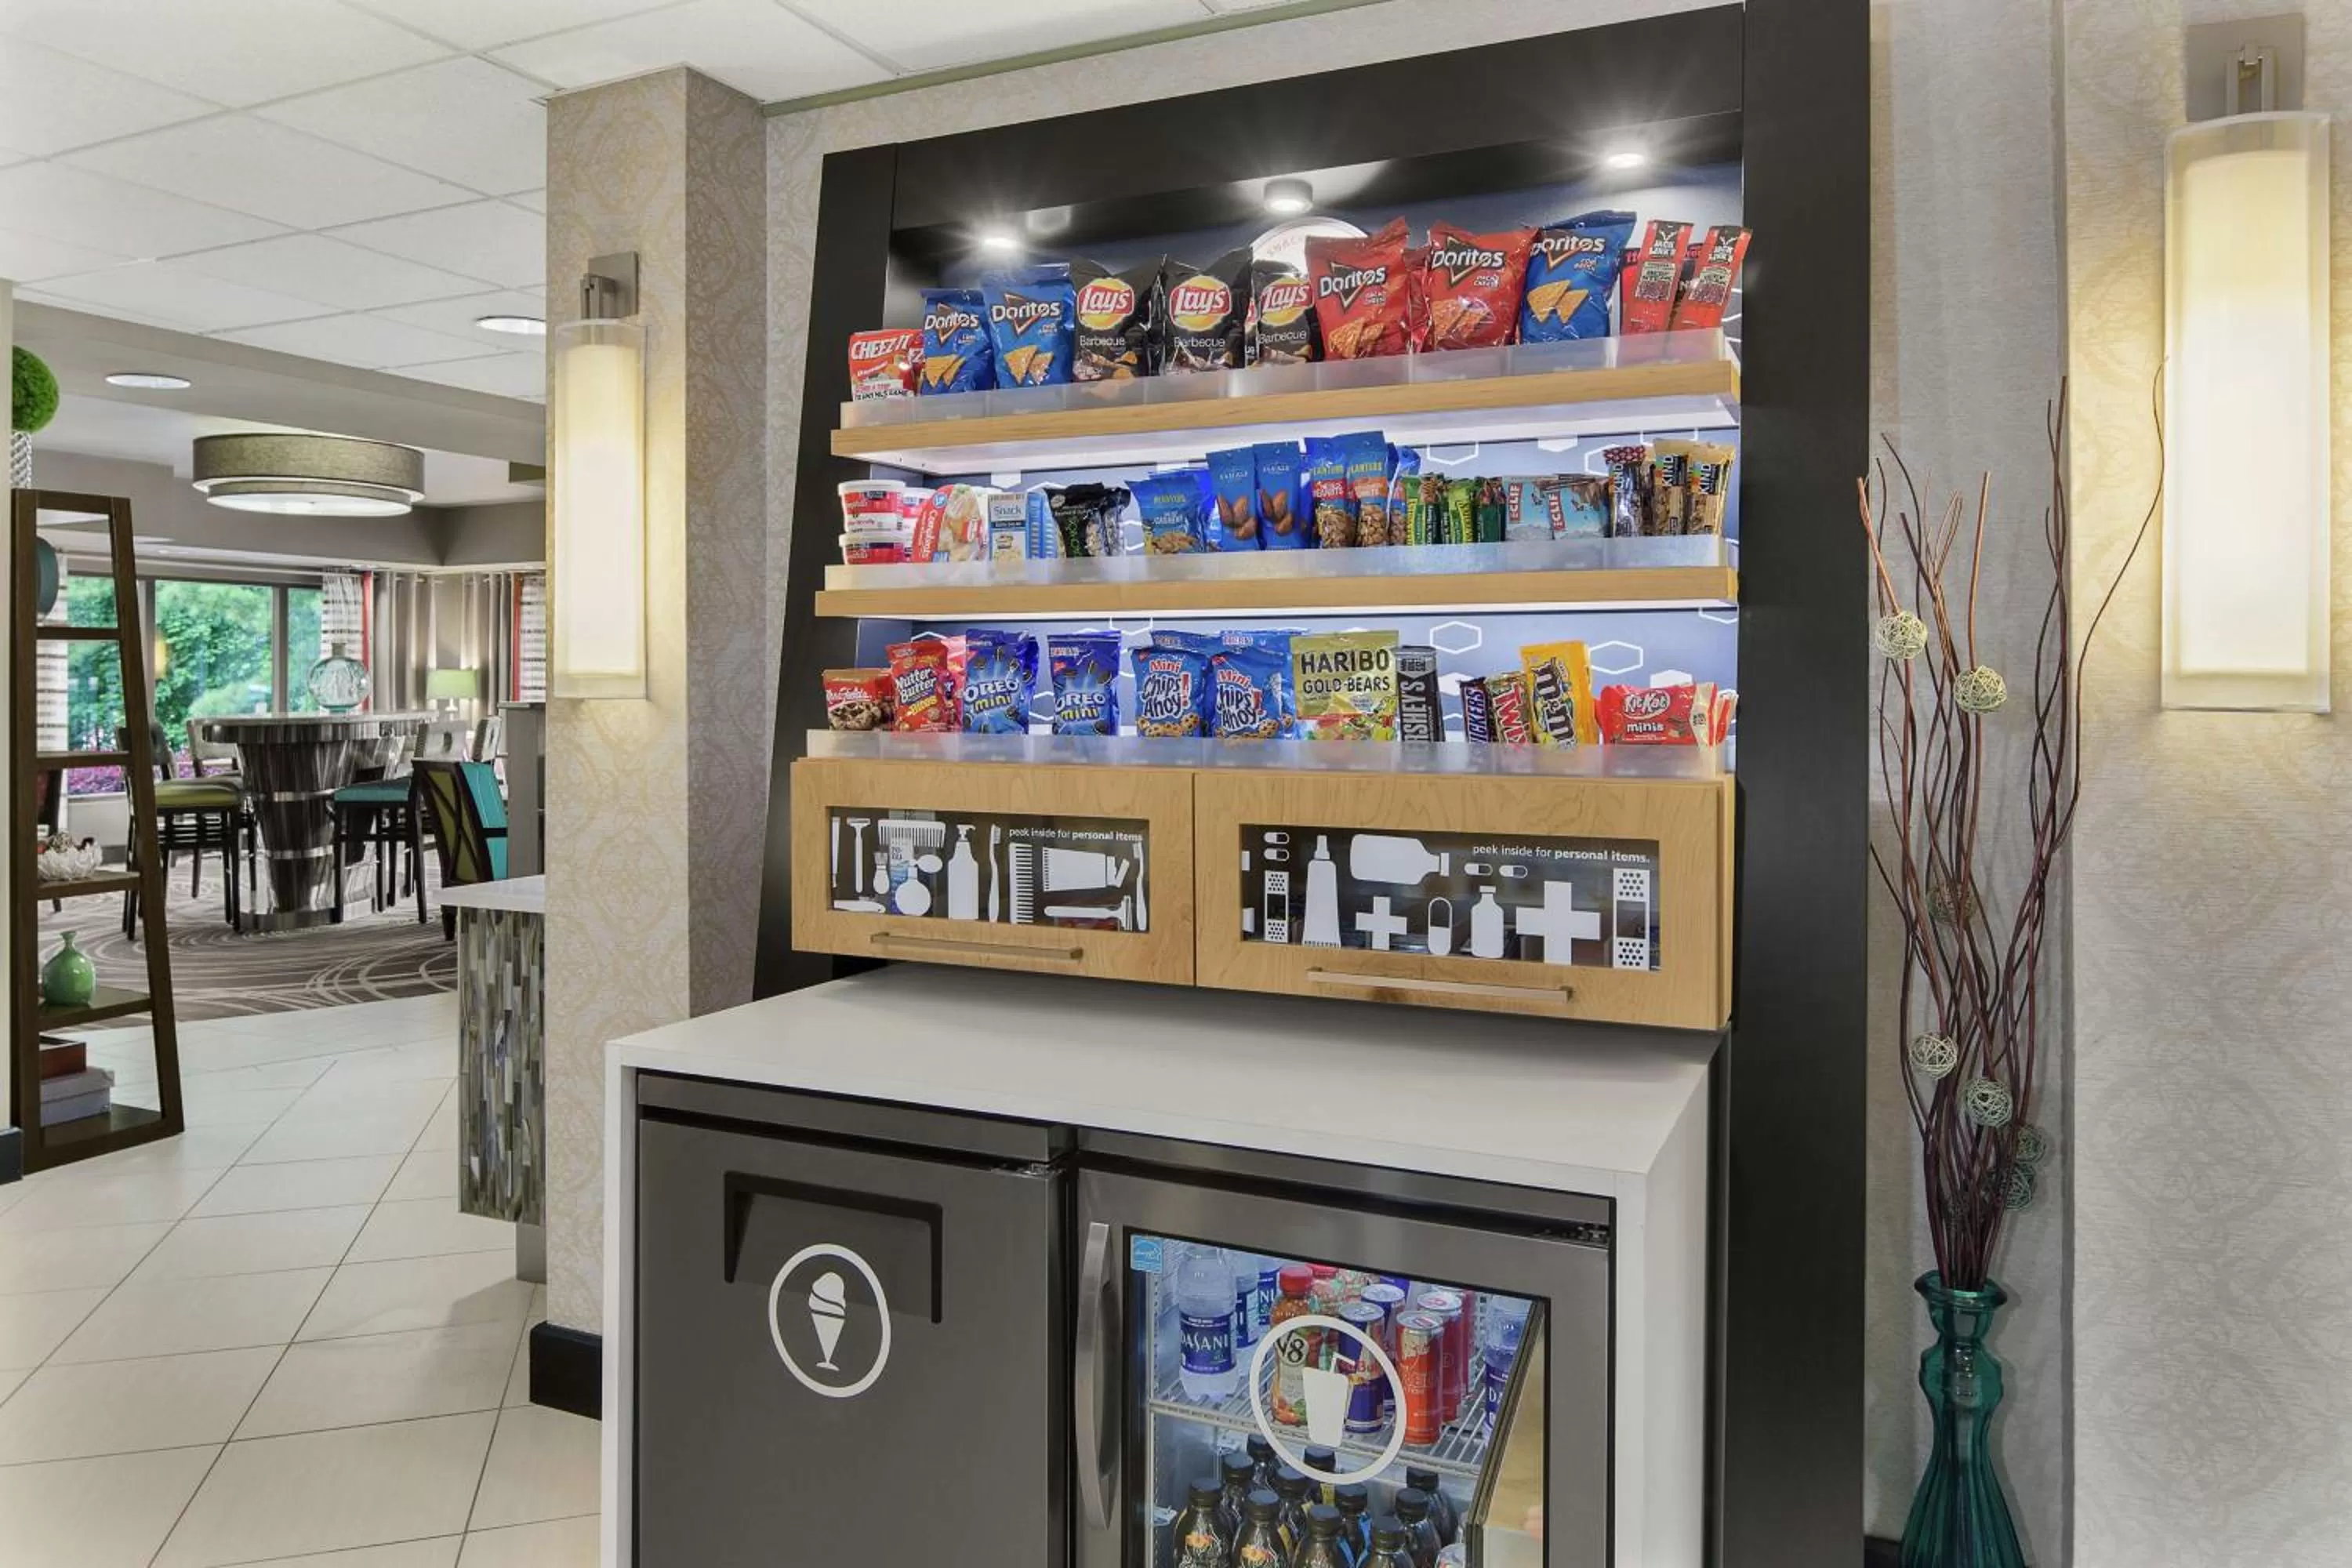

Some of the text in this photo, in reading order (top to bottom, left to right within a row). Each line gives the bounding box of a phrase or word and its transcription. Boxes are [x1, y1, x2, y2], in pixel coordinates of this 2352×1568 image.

[1432, 250, 1505, 268] Doritos
[1319, 267, 1387, 298] Doritos
[991, 301, 1062, 322] Doritos
[924, 313, 979, 331] Doritos
[1079, 335, 1127, 347] Barbecue
[1174, 336, 1226, 349] Barbecue
[1259, 330, 1308, 343] Barbecue
[1614, 463, 1624, 493] KIND
[1662, 456, 1674, 487] KIND
[1700, 463, 1711, 495] KIND
[1150, 658, 1182, 673] Mini
[1301, 648, 1389, 674] HARIBO
[895, 668, 932, 689] Nutter
[1142, 673, 1182, 699] Chips
[1218, 669, 1252, 687] Mini
[1302, 675, 1391, 695] GOLD-BEARS
[901, 677, 938, 703] Butter
[964, 678, 1019, 702] OREO
[974, 694, 1011, 713] mini
[1054, 692, 1106, 712] OREO
[1399, 681, 1429, 742] SHEY'S
[1060, 708, 1099, 721] mini
[1466, 686, 1487, 743] ICKERS
[1626, 722, 1664, 734] minis
[1009, 827, 1029, 837] peek
[1031, 827, 1056, 839] inside
[1058, 828, 1071, 839] for
[1072, 830, 1113, 841] personal
[1472, 844, 1498, 856] peek
[1501, 844, 1533, 857] inside
[1535, 846, 1552, 857] for
[1555, 848, 1608, 861] personal
[1276, 1331, 1305, 1363] V8
